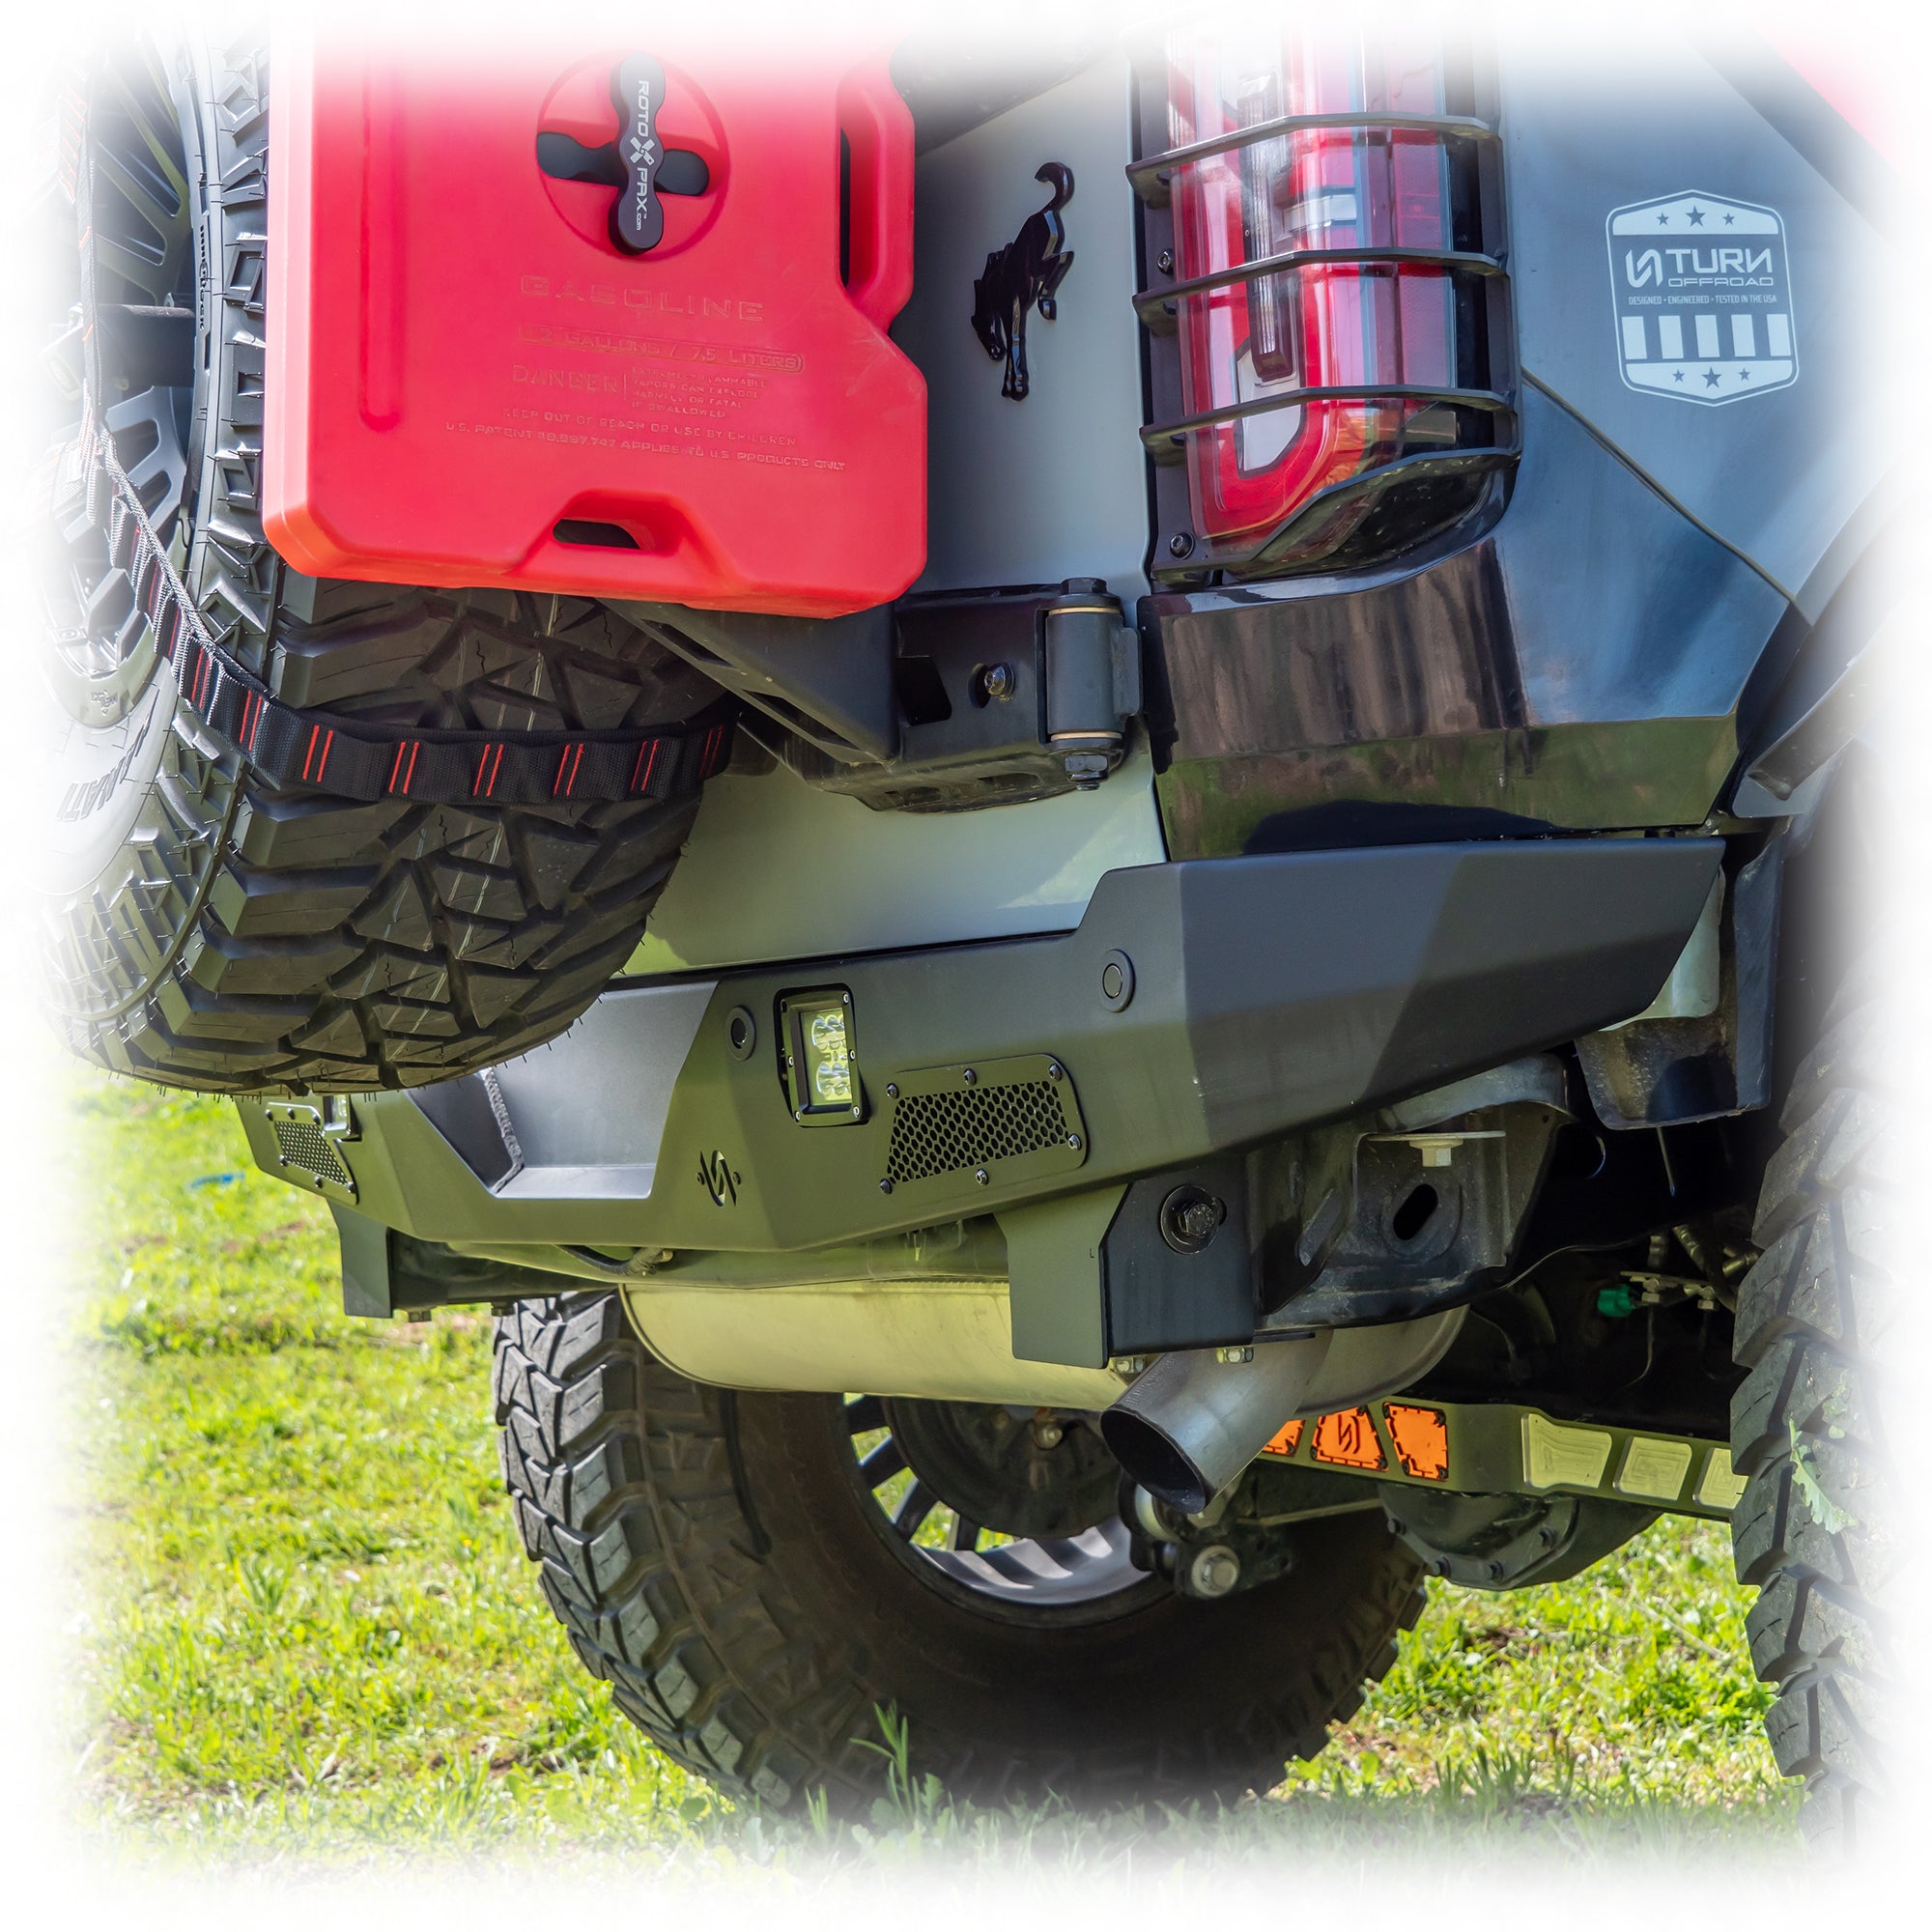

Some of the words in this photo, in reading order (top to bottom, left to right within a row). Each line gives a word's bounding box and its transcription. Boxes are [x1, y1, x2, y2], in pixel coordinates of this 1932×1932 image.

[638, 80, 649, 137] ROTO
[1665, 247, 1774, 273] TURN
[1668, 276, 1774, 288] OFFROAD
[520, 274, 766, 324] GASOLINE
[1628, 296, 1662, 305] DESIGNED
[1667, 295, 1710, 304] ENGINEERED
[1715, 295, 1740, 304] TESTED
[1740, 294, 1748, 303] IN
[1749, 294, 1763, 303] THE
[1763, 294, 1777, 303] USA
[564, 330, 661, 355] GALLONS
[728, 348, 798, 370] LITERS
[512, 363, 619, 394] DANGER
[681, 384, 704, 394] CAN
[648, 403, 725, 419] SWALLOWED
[690, 396, 705, 406] OR
[709, 398, 742, 410] FATAL
[503, 408, 539, 419] KEEP
[544, 411, 571, 423] OUT
[577, 415, 593, 425] OF
[600, 418, 645, 430] REACH
[651, 422, 669, 434] OR
[674, 425, 701, 438] USE
[707, 428, 724, 439] BY
[728, 431, 796, 446] CHILDREN
[474, 424, 533, 440] PATENT
[620, 440, 680, 454] APPLIES
[687, 445, 704, 457] TO
[737, 451, 810, 468] PRODUCTS
[814, 458, 845, 471] ONLY
